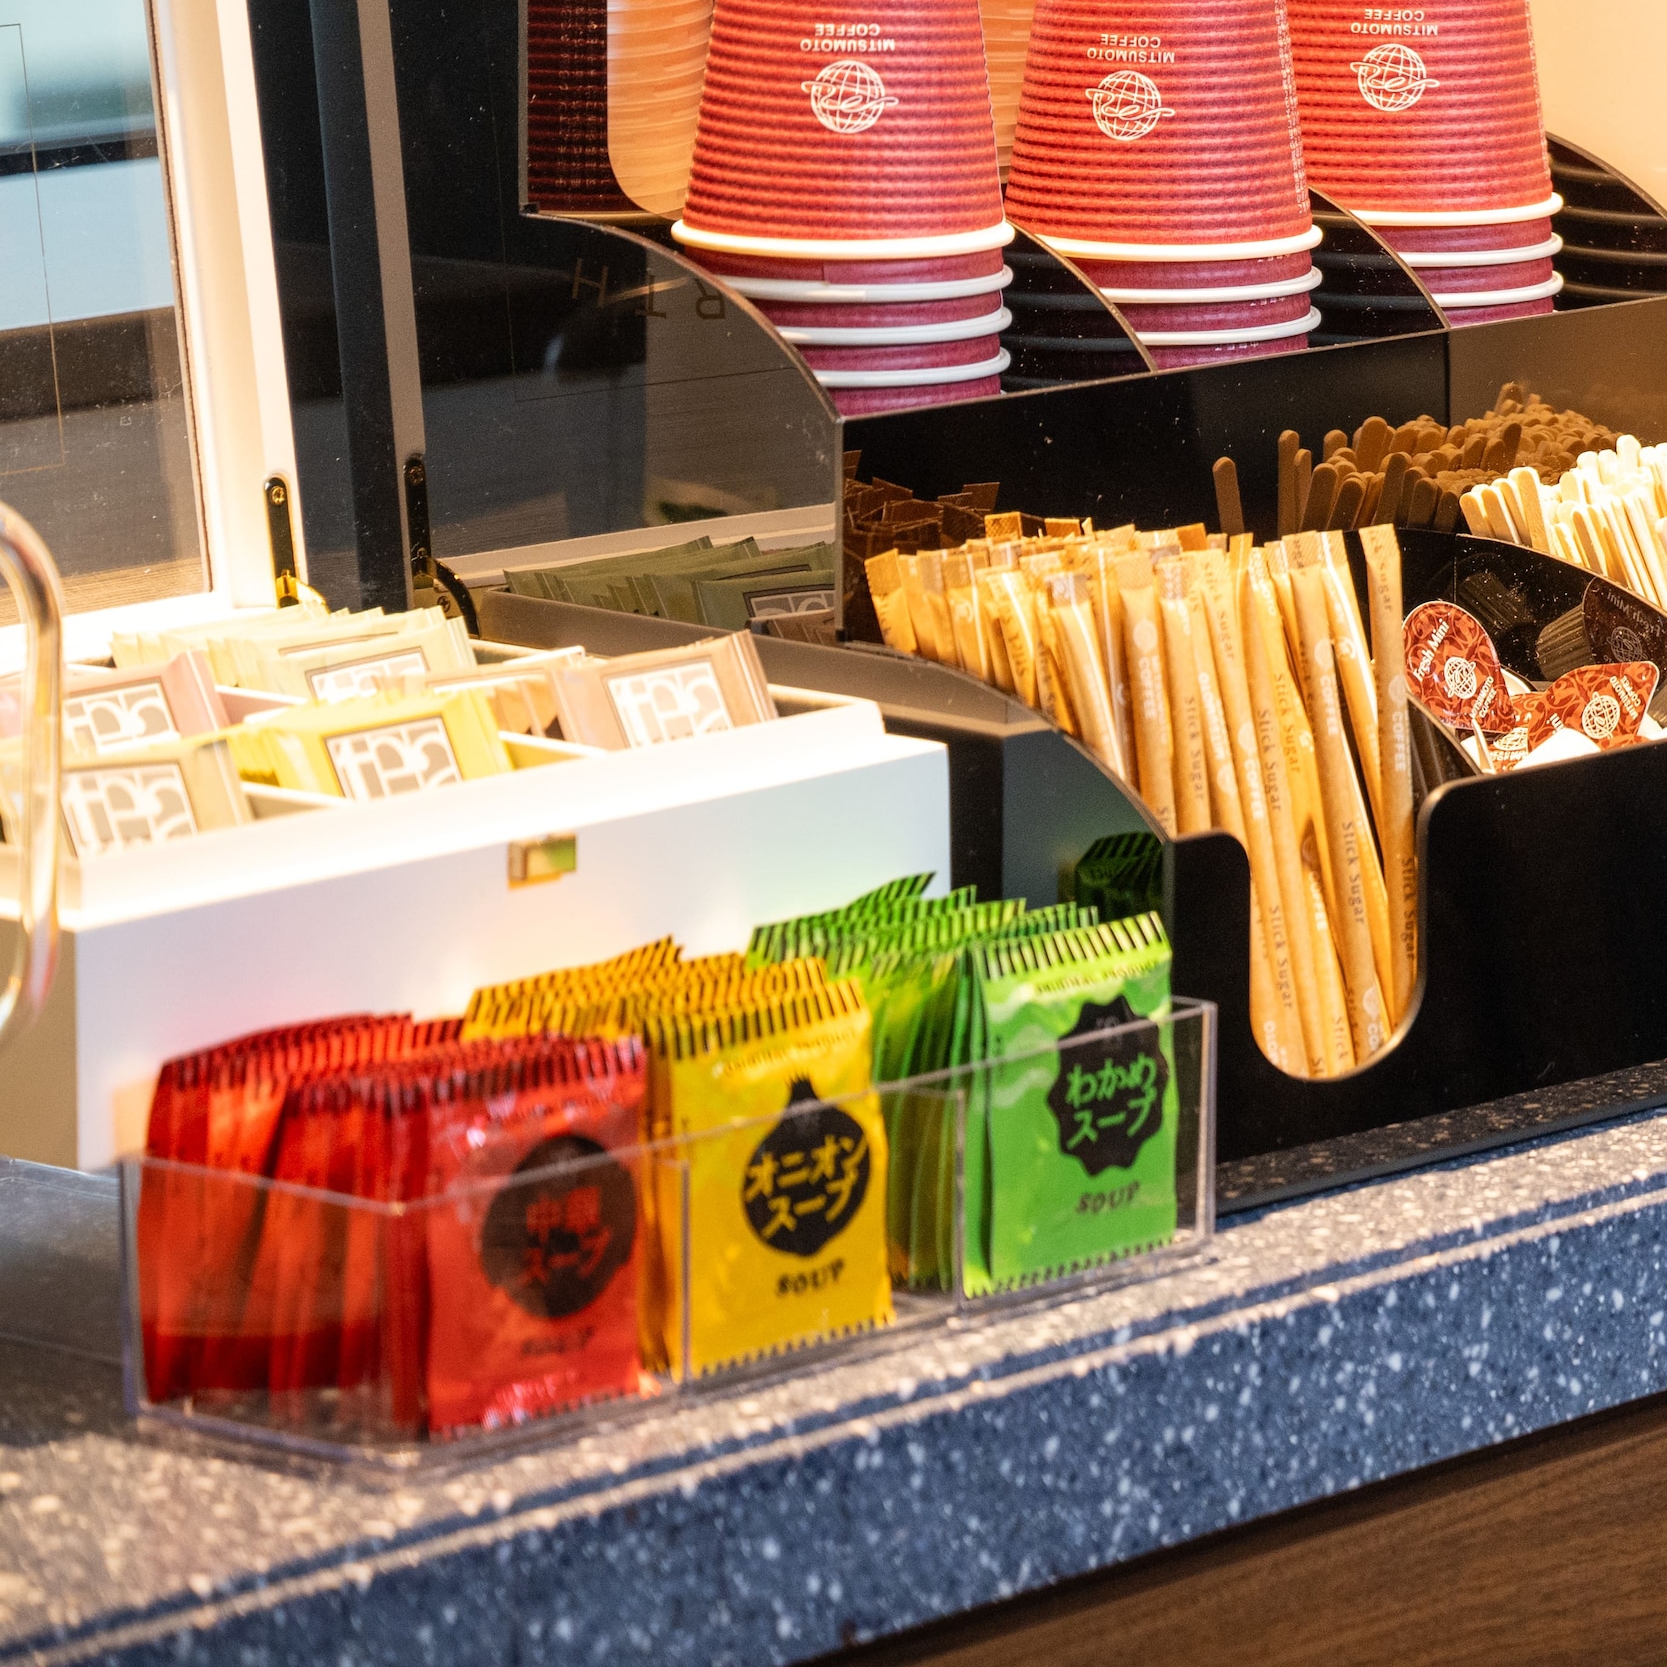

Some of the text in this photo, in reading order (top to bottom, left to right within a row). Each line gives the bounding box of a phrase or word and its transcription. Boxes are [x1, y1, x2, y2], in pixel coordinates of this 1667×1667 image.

[815, 22, 881, 36] COFFEE
[1100, 34, 1161, 48] COFFEE
[1350, 21, 1439, 37] MITSUMOTO
[1364, 8, 1425, 22] COFFEE
[800, 38, 895, 52] MITSUMOTO
[1087, 47, 1175, 63] MITSUMOTO
[1412, 618, 1450, 682] Fresh Mini
[1319, 675, 1339, 736] COFFEE
[1469, 675, 1494, 720] MITSUMOTO
[1478, 688, 1498, 719] COFFEE
[1609, 675, 1639, 720] MITSUMOTO
[1619, 675, 1642, 707] COFFEE
[1185, 695, 1204, 800] Stick Sugar
[1274, 673, 1300, 774] Stick Sugar
[1392, 711, 1407, 772] COFFEE
[1244, 758, 1264, 821] COFFEE
[1256, 709, 1282, 812] Stick Sugar
[1342, 821, 1365, 925] Stick Sugar
[1401, 857, 1417, 962] Stick Sugar
[1269, 906, 1293, 1009] Stick Sugar
[1332, 1016, 1348, 1060] Stick
[1066, 1051, 1157, 1110] わかめ
[1068, 1087, 1157, 1149] スープ
[744, 1132, 870, 1204] オニオン
[765, 1178, 862, 1243] スープ
[1074, 1180, 1143, 1217] SOUP
[775, 1258, 847, 1298] SOUP
